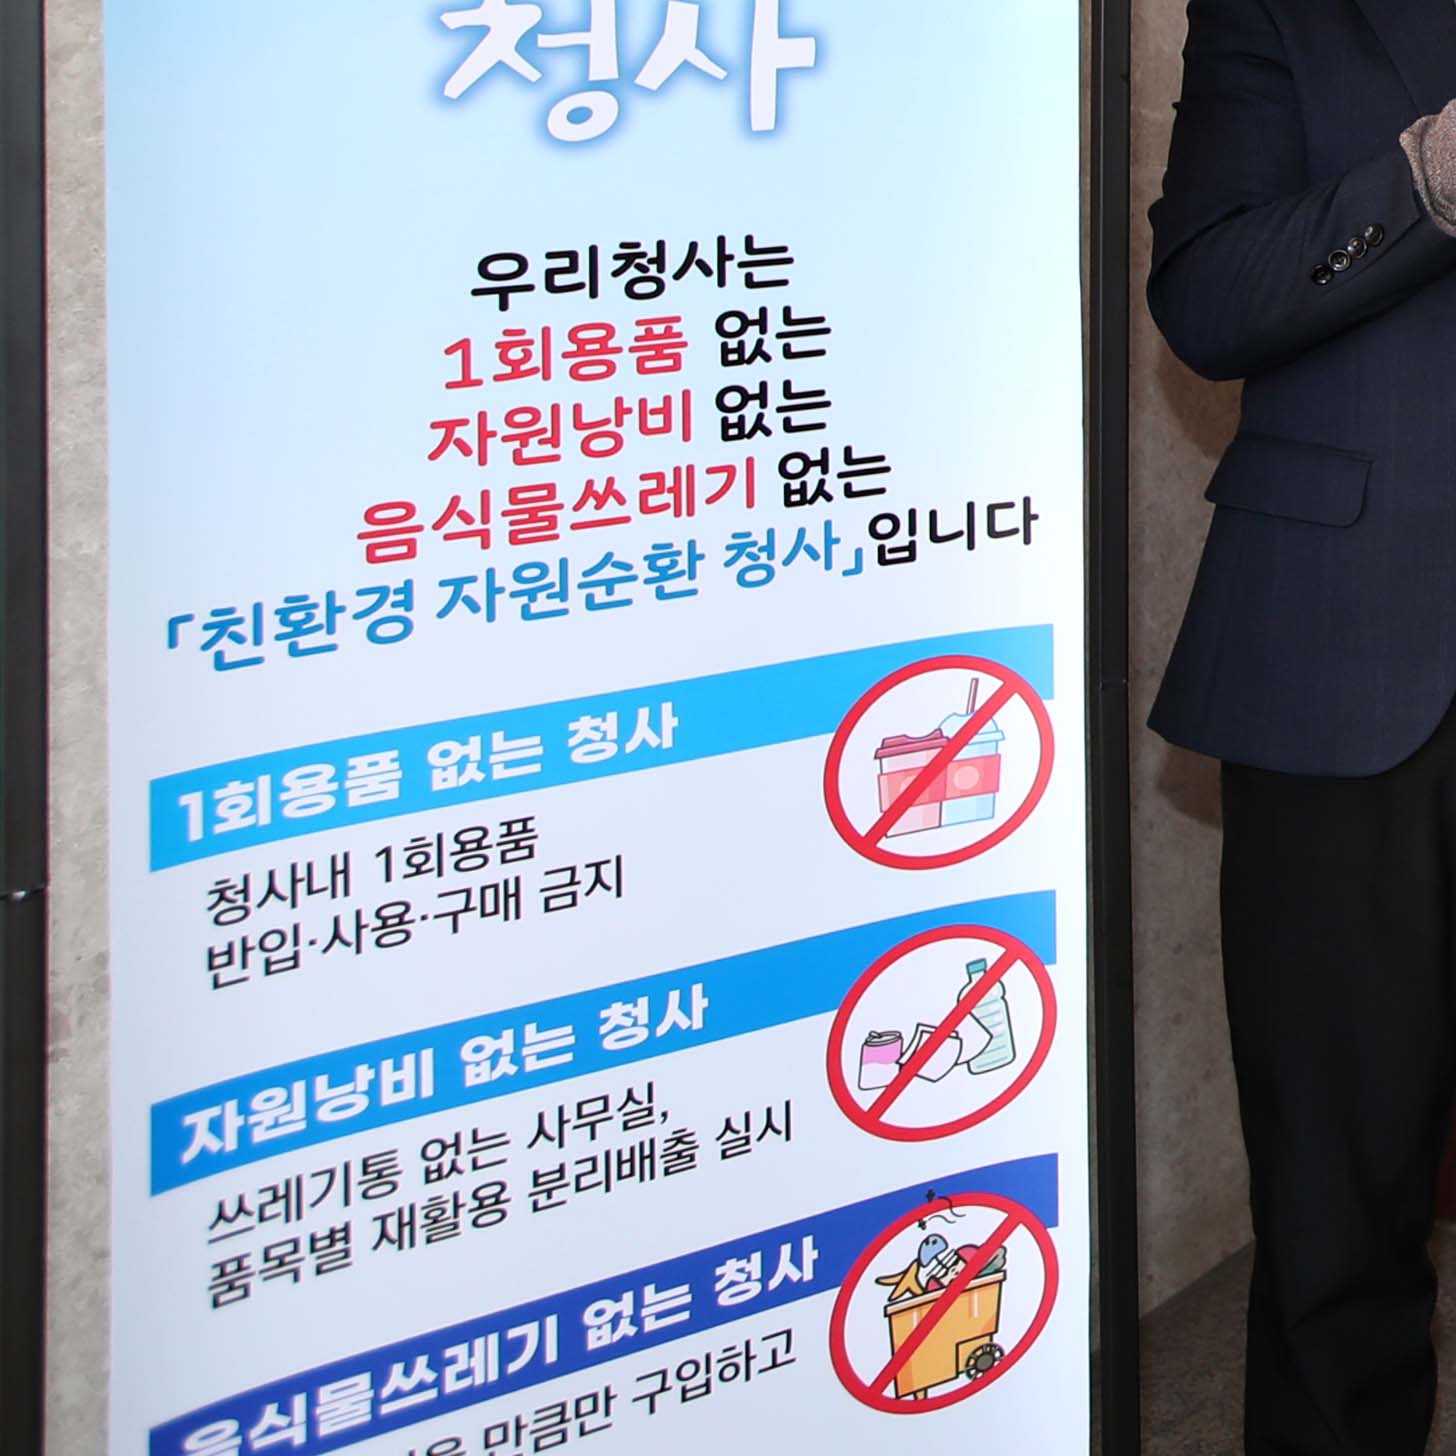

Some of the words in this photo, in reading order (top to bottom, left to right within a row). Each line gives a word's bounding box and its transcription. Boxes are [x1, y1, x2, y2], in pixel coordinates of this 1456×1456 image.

[471, 235, 794, 311] 우리청사는
[444, 316, 688, 389] 1회용품
[714, 306, 832, 368] 없는
[428, 389, 692, 466] 자원낭비
[715, 380, 832, 442] 없는
[358, 456, 756, 564] 음식물쓰레기
[777, 446, 892, 508] 없는
[167, 579, 414, 672] 「친환경
[436, 538, 704, 622] 자원순환
[178, 747, 403, 844] 1회용품
[427, 733, 544, 796] 없는
[567, 702, 678, 767] 청사
[207, 851, 351, 925] 청사내
[375, 817, 538, 883] 1회용품
[539, 855, 623, 912] 금지
[181, 1049, 436, 1165] 자원낭비
[459, 1022, 576, 1085] 없는
[600, 984, 710, 1052] 청사
[209, 1150, 402, 1240] 쓰레기통
[420, 1129, 510, 1185] 없는
[527, 1082, 669, 1149] 사무실,
[209, 1222, 351, 1309] 품목별
[372, 1182, 510, 1250] 재활용
[528, 1129, 700, 1213] 분리배출
[715, 1101, 792, 1161] 실시
[183, 1316, 557, 1456] 음식물쓰레기
[581, 1281, 694, 1347] 없는
[714, 1235, 818, 1305] 청사
[484, 1386, 617, 1456] 만큼만
[632, 1328, 797, 1414] 구입하고
